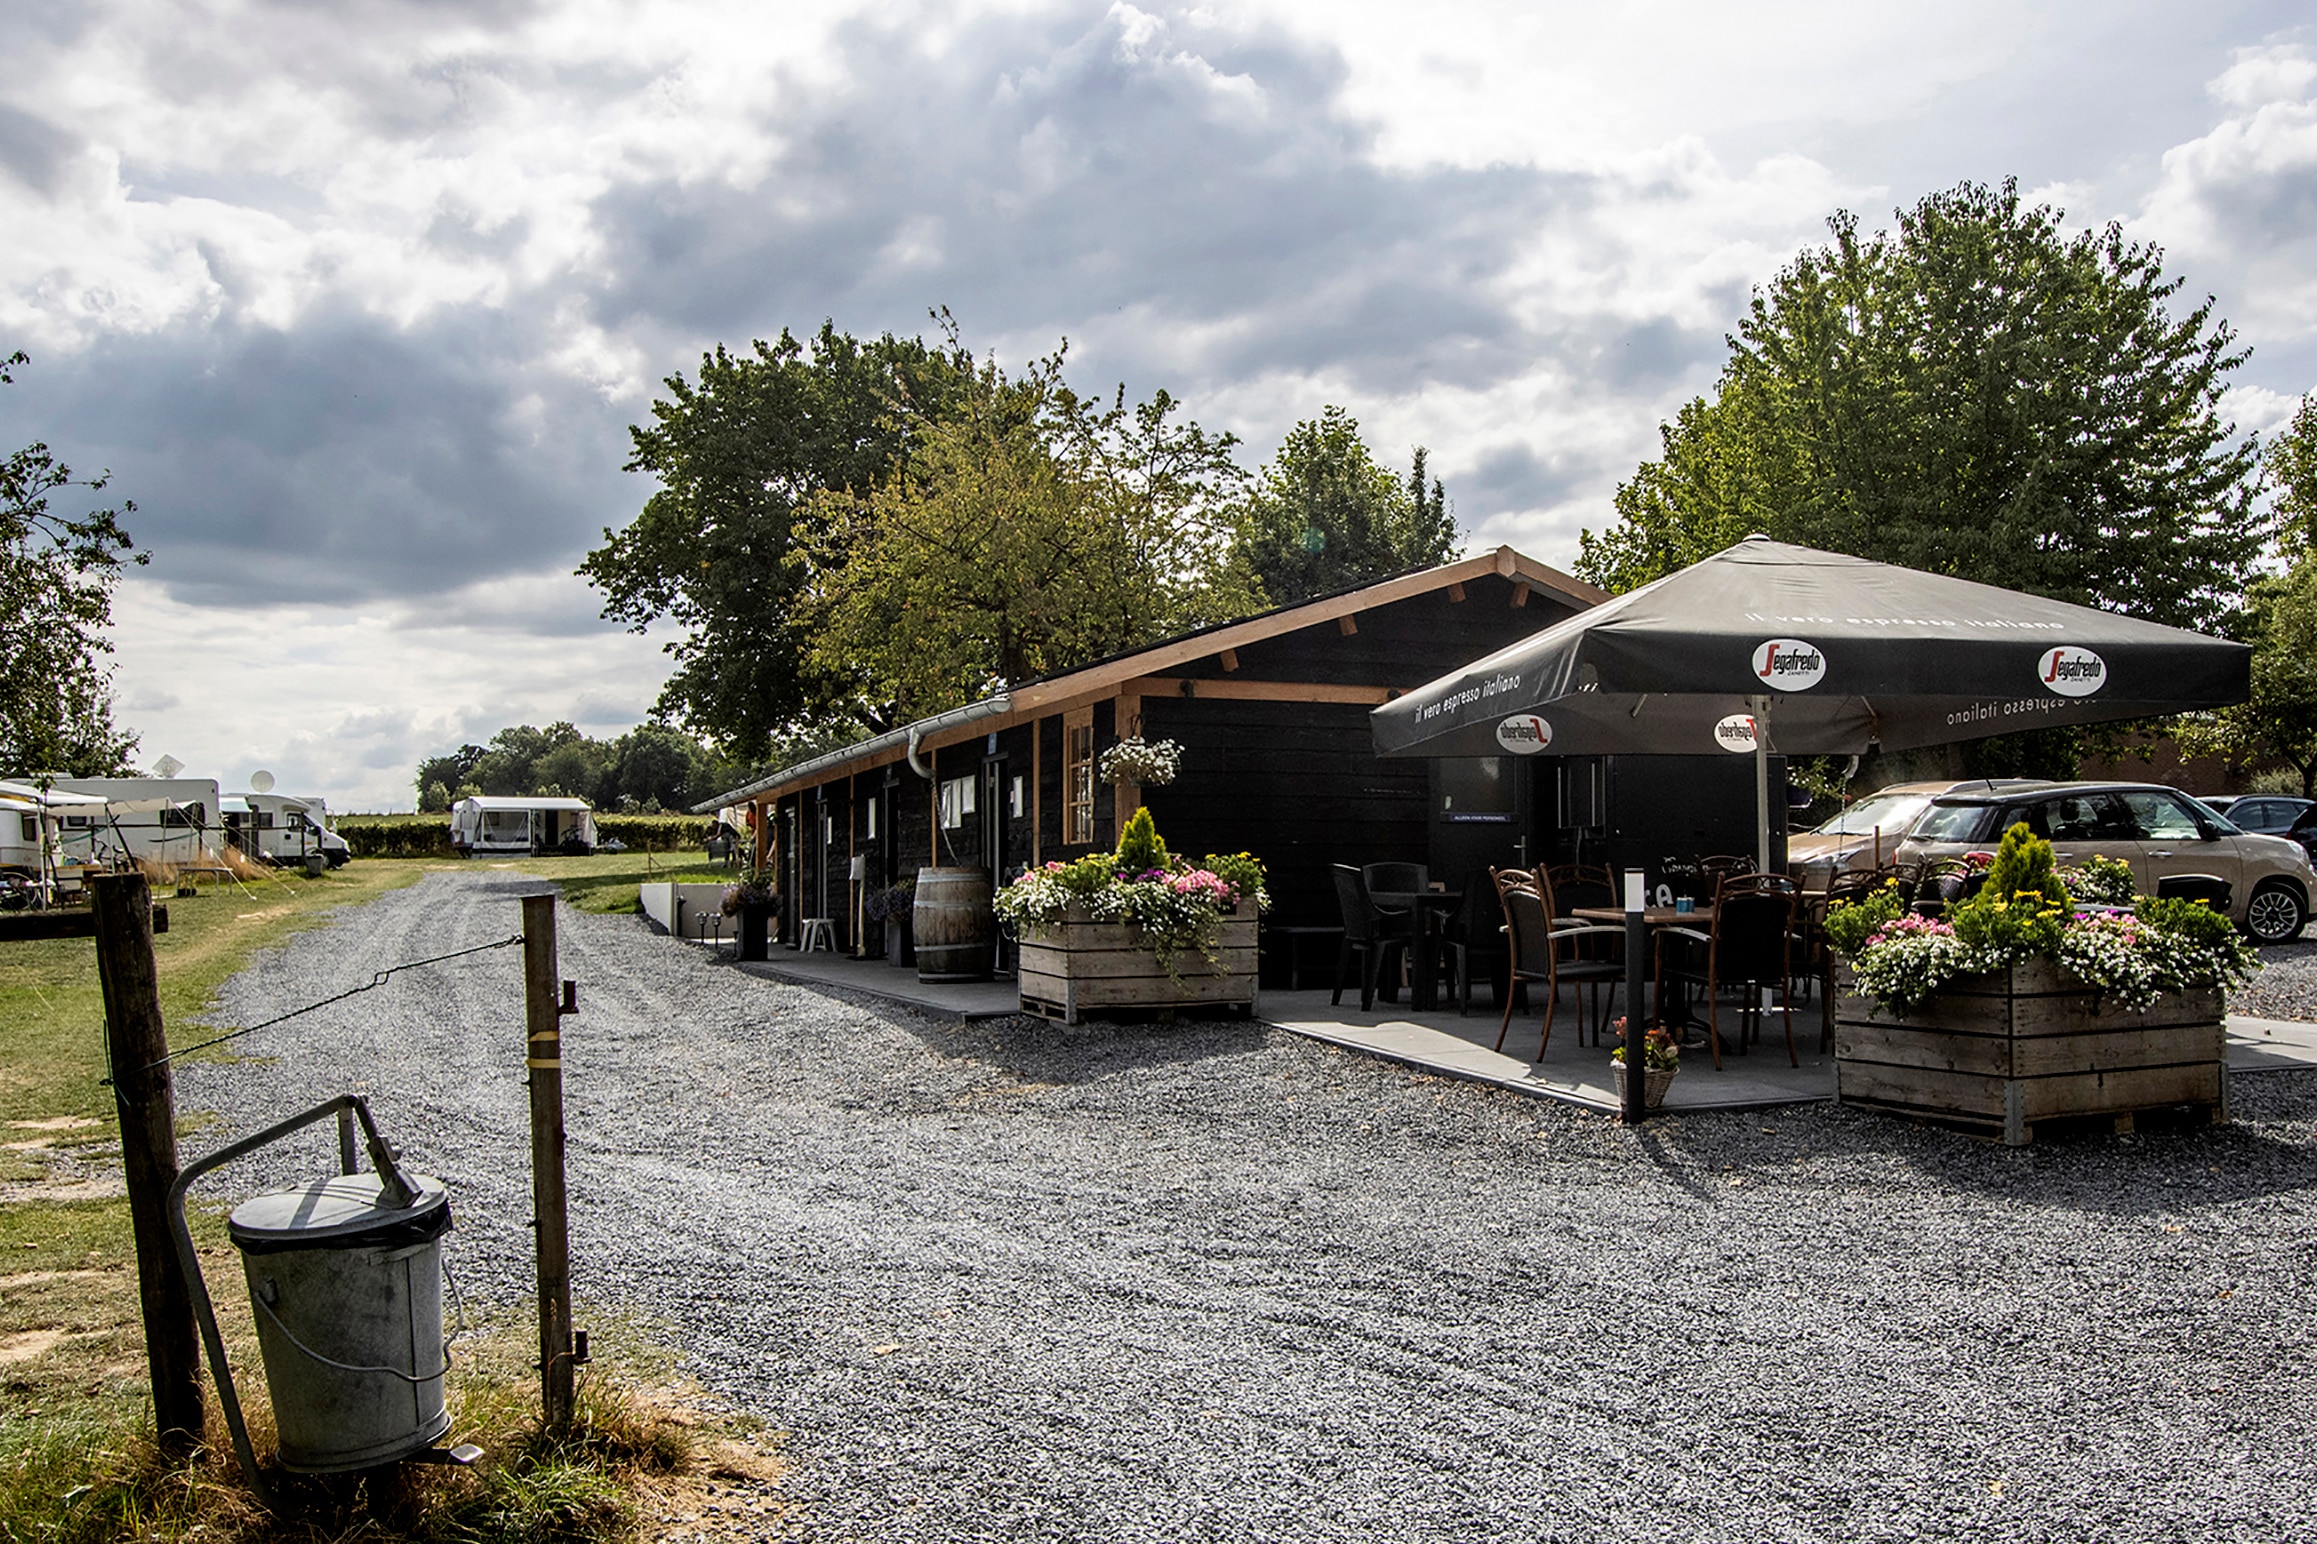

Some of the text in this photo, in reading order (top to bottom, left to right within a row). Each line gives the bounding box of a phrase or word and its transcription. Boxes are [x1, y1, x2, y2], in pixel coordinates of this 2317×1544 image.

[1775, 615, 1834, 624] vero
[1846, 617, 1956, 626] espresso
[1963, 618, 2065, 629] italiano
[1759, 643, 1821, 676] Segafredo
[2044, 650, 2102, 682] Segafredo
[1414, 673, 1521, 723] il vero espresso italiano
